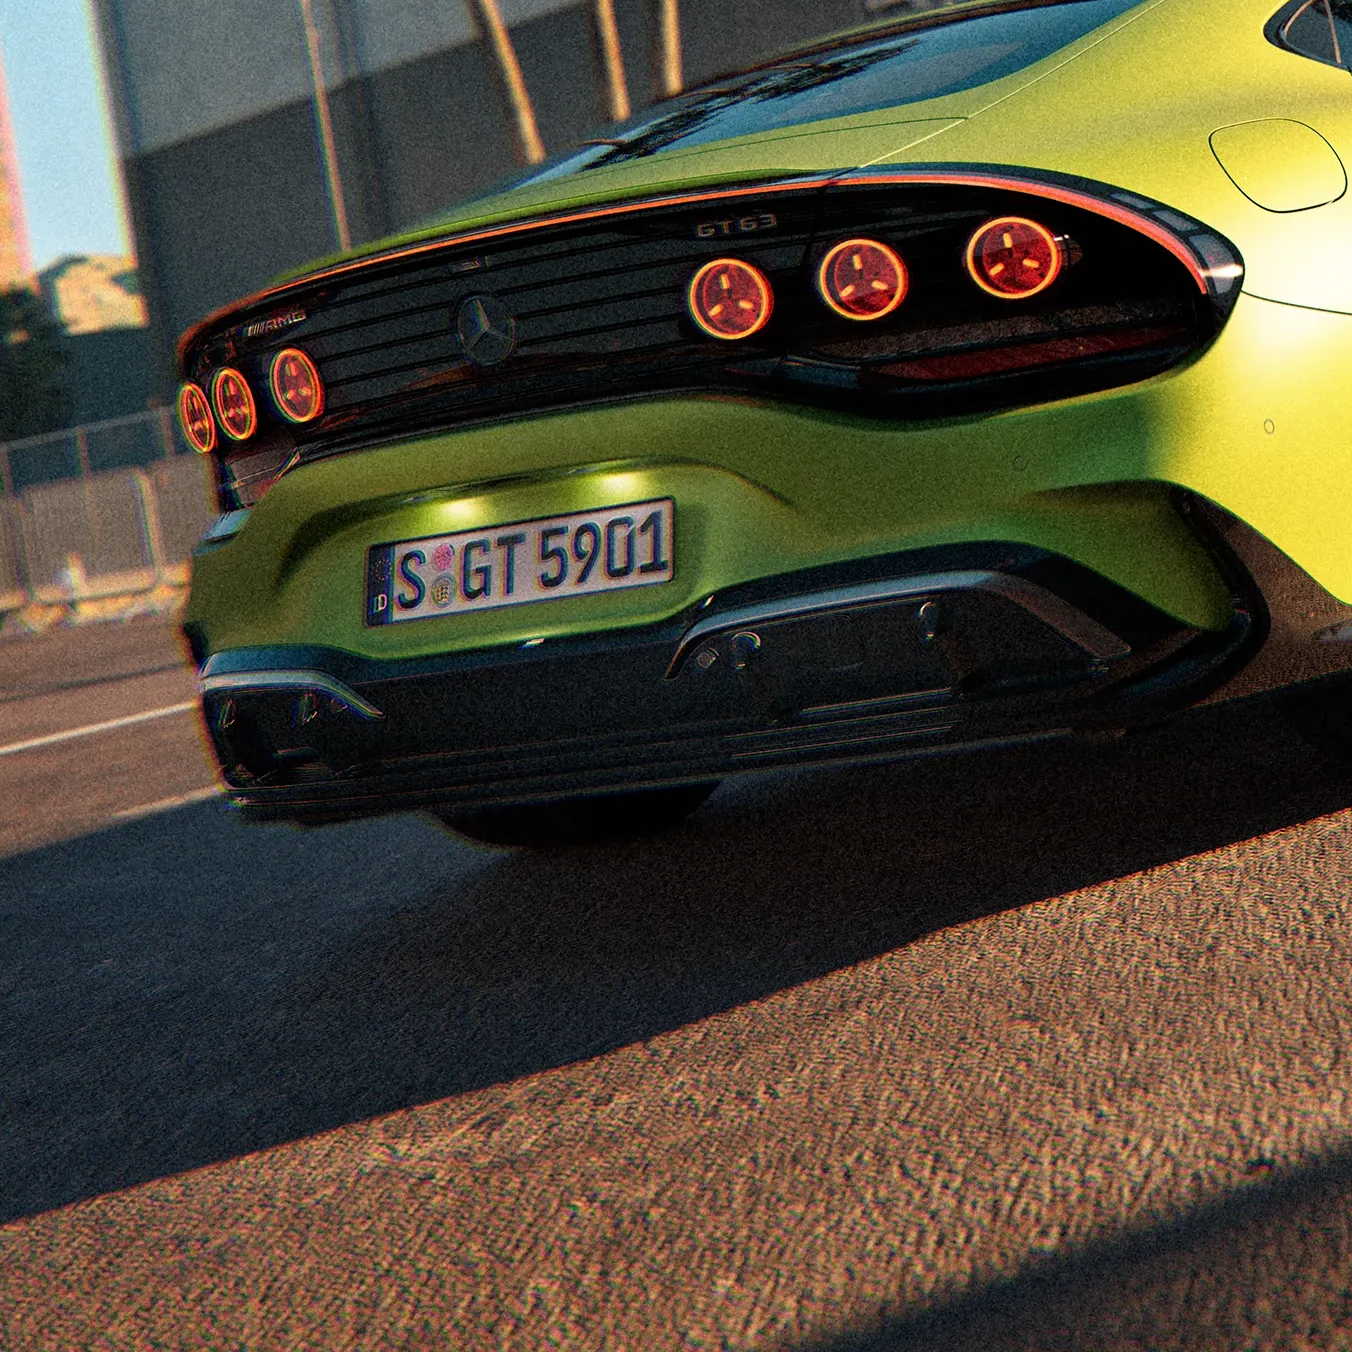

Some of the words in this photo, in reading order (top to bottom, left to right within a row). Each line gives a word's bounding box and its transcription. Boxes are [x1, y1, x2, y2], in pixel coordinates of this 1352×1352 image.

[698, 220, 734, 237] GT
[740, 213, 777, 231] 63
[264, 310, 307, 333] AMG
[396, 549, 427, 610] S
[461, 532, 526, 601] GT
[538, 509, 669, 589] 5901
[375, 593, 388, 612] D
